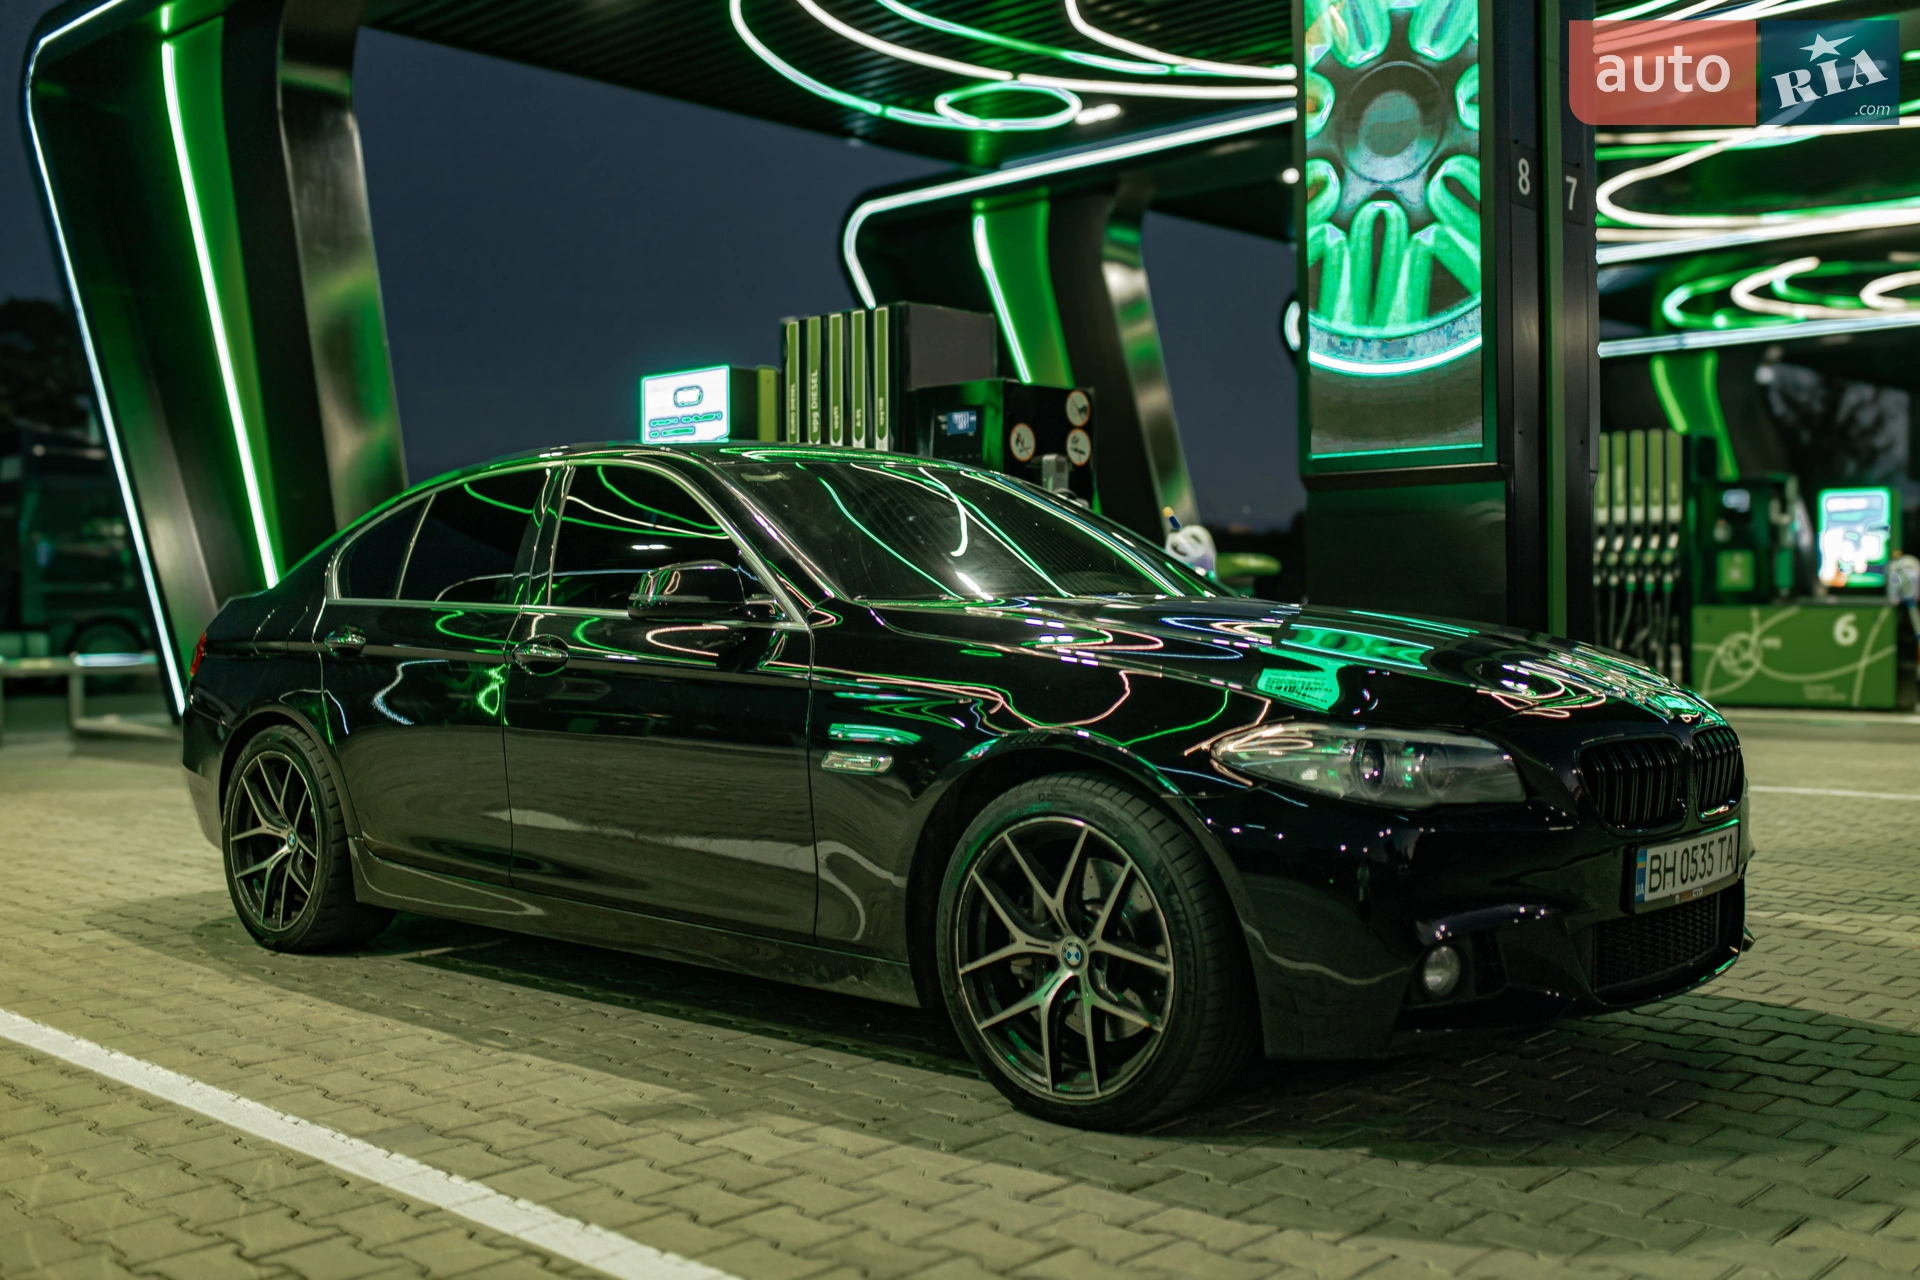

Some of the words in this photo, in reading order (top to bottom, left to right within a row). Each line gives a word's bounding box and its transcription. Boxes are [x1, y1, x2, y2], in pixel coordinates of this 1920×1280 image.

[1518, 157, 1531, 196] 8
[1565, 175, 1578, 211] 7
[811, 369, 819, 409] DIESEL
[811, 411, 820, 433] upg
[1832, 612, 1859, 647] 6
[1648, 850, 1677, 894] BH
[1680, 840, 1715, 886] 0535
[1718, 834, 1735, 873] TA
[1636, 883, 1645, 897] UA
